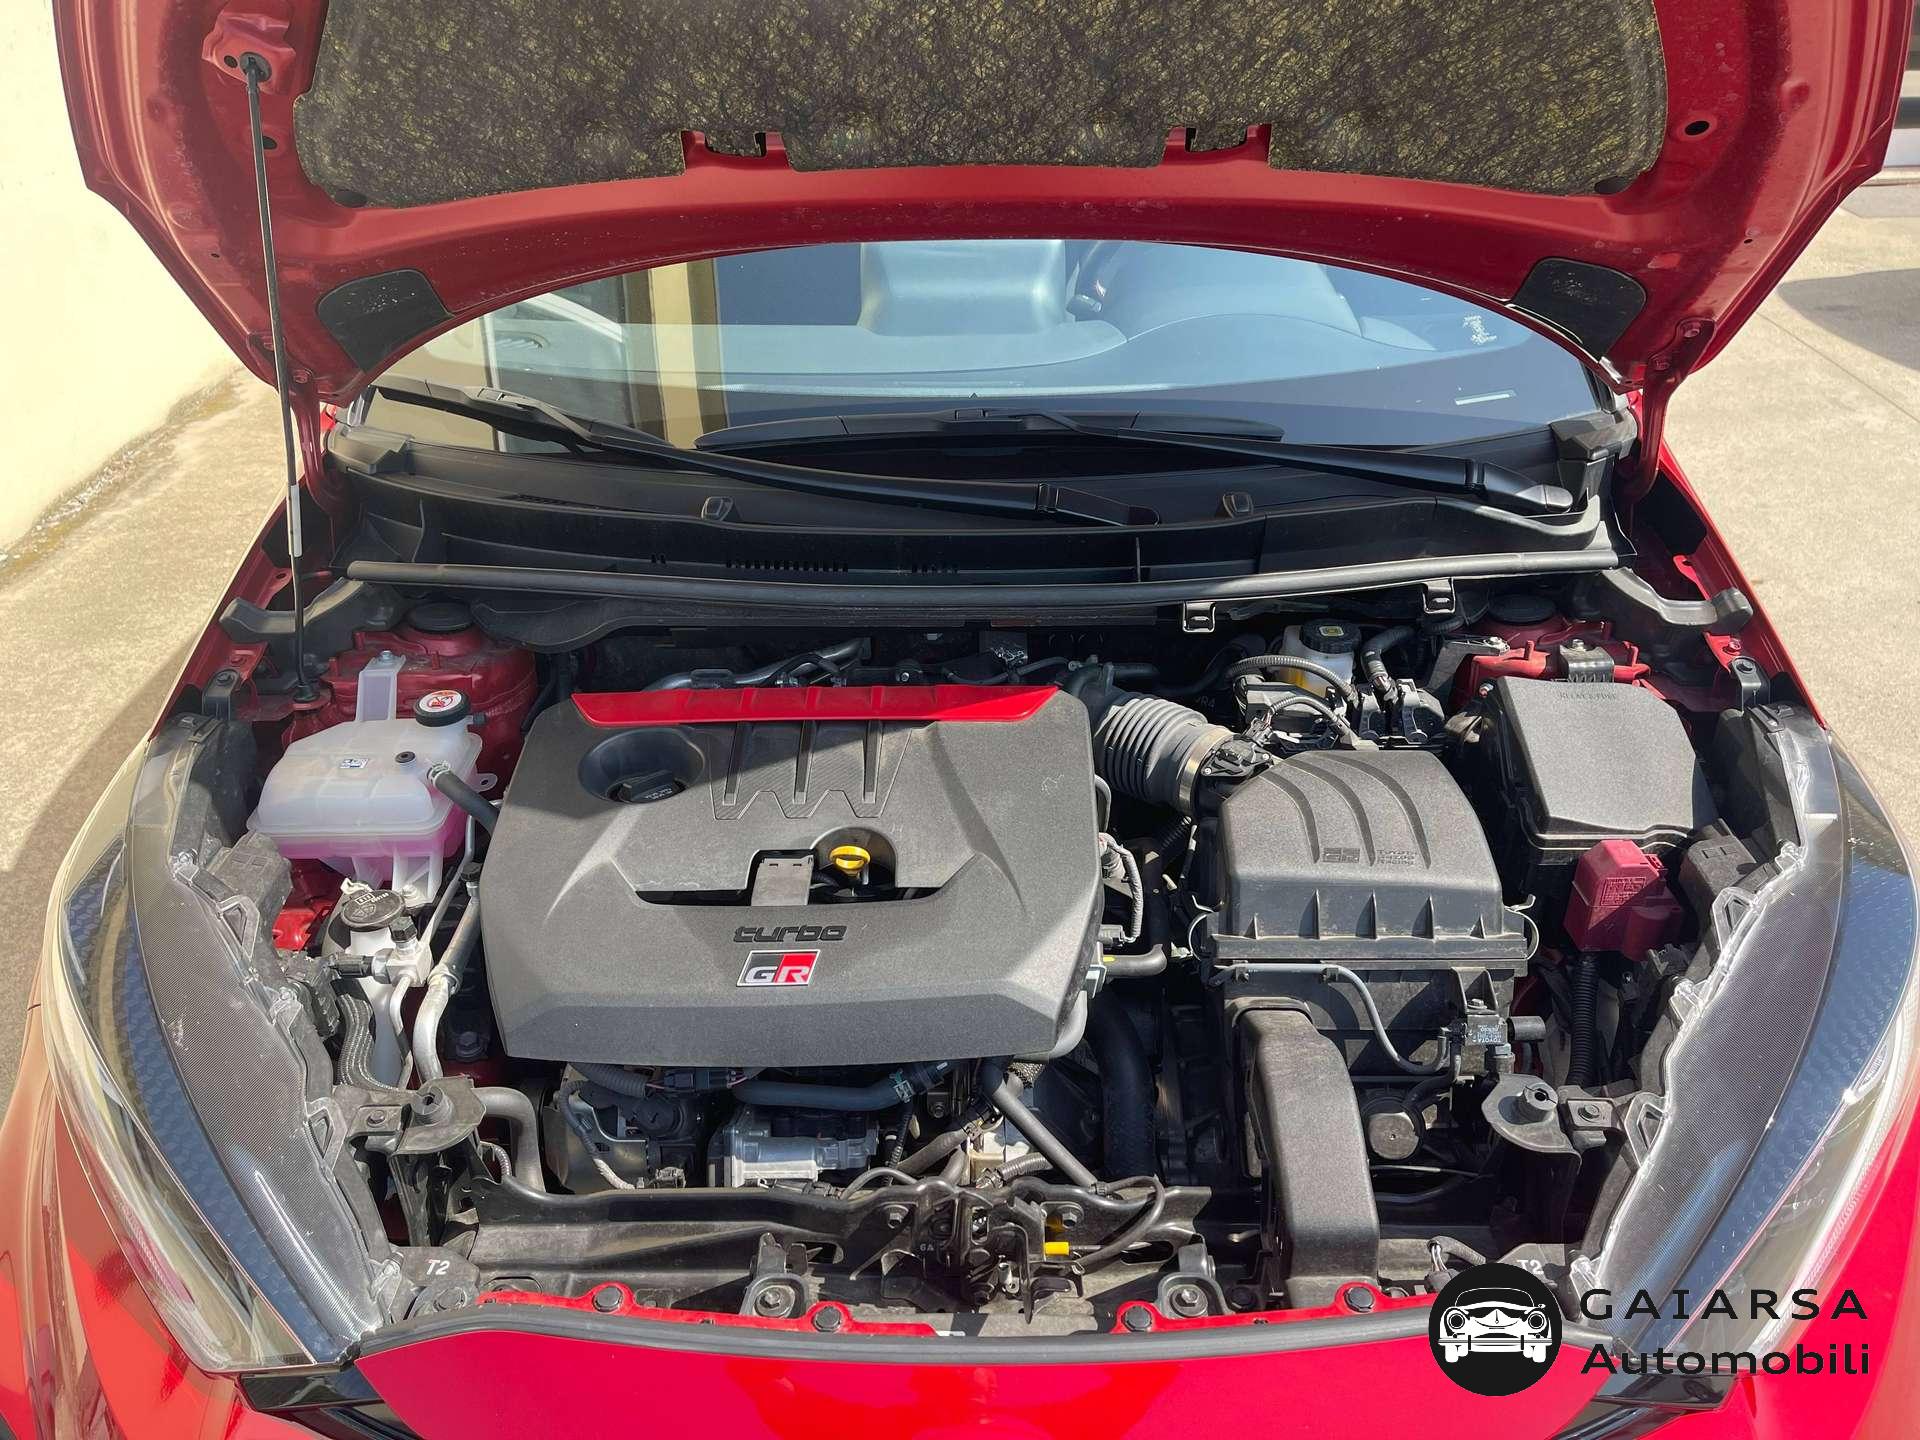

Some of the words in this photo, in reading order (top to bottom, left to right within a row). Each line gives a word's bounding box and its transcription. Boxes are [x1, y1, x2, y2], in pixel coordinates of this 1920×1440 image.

[733, 925, 847, 942] turbo
[744, 965, 811, 983] GR
[426, 1258, 450, 1275] T2
